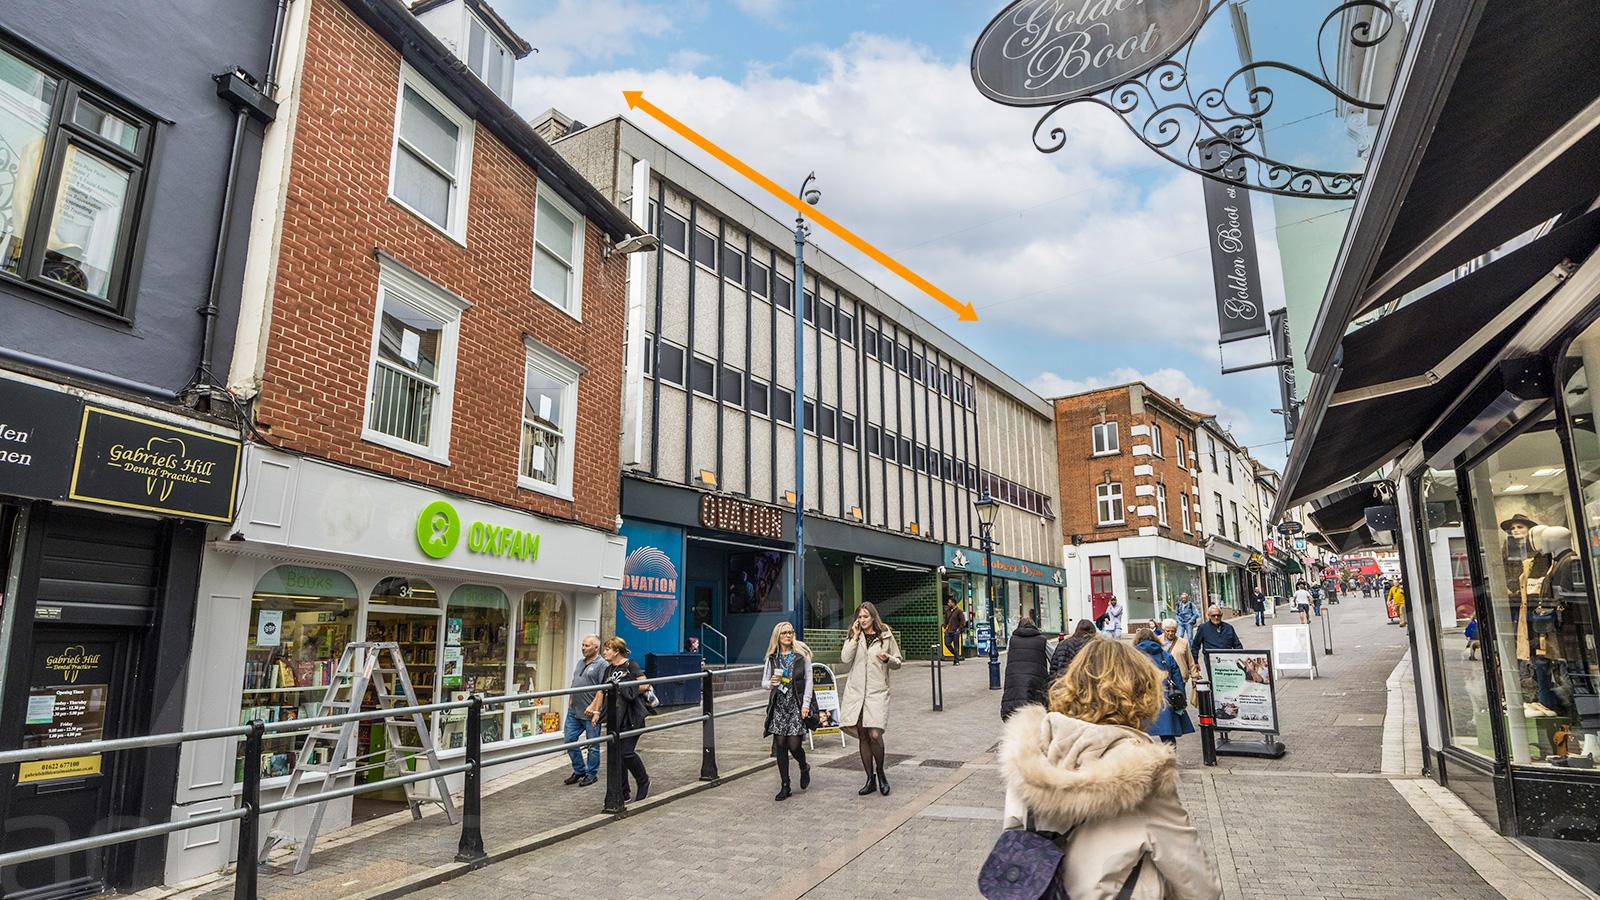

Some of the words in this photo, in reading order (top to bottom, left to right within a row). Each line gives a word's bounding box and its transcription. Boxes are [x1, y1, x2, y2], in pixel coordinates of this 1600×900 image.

[1003, 0, 1145, 59] Golde
[1024, 23, 1159, 90] Boot
[1216, 205, 1243, 254] Boot
[1223, 256, 1257, 320] Golden
[110, 444, 177, 469] Gabriels
[181, 459, 216, 476] Hill
[124, 463, 160, 476] Dental
[160, 469, 198, 484] Practice
[699, 494, 783, 540] OVATION
[469, 521, 541, 561] OXFAM
[399, 585, 413, 599] 34
[623, 575, 677, 593] OVATION
[46, 655, 81, 666] Gabriels
[82, 655, 101, 664] Hill
